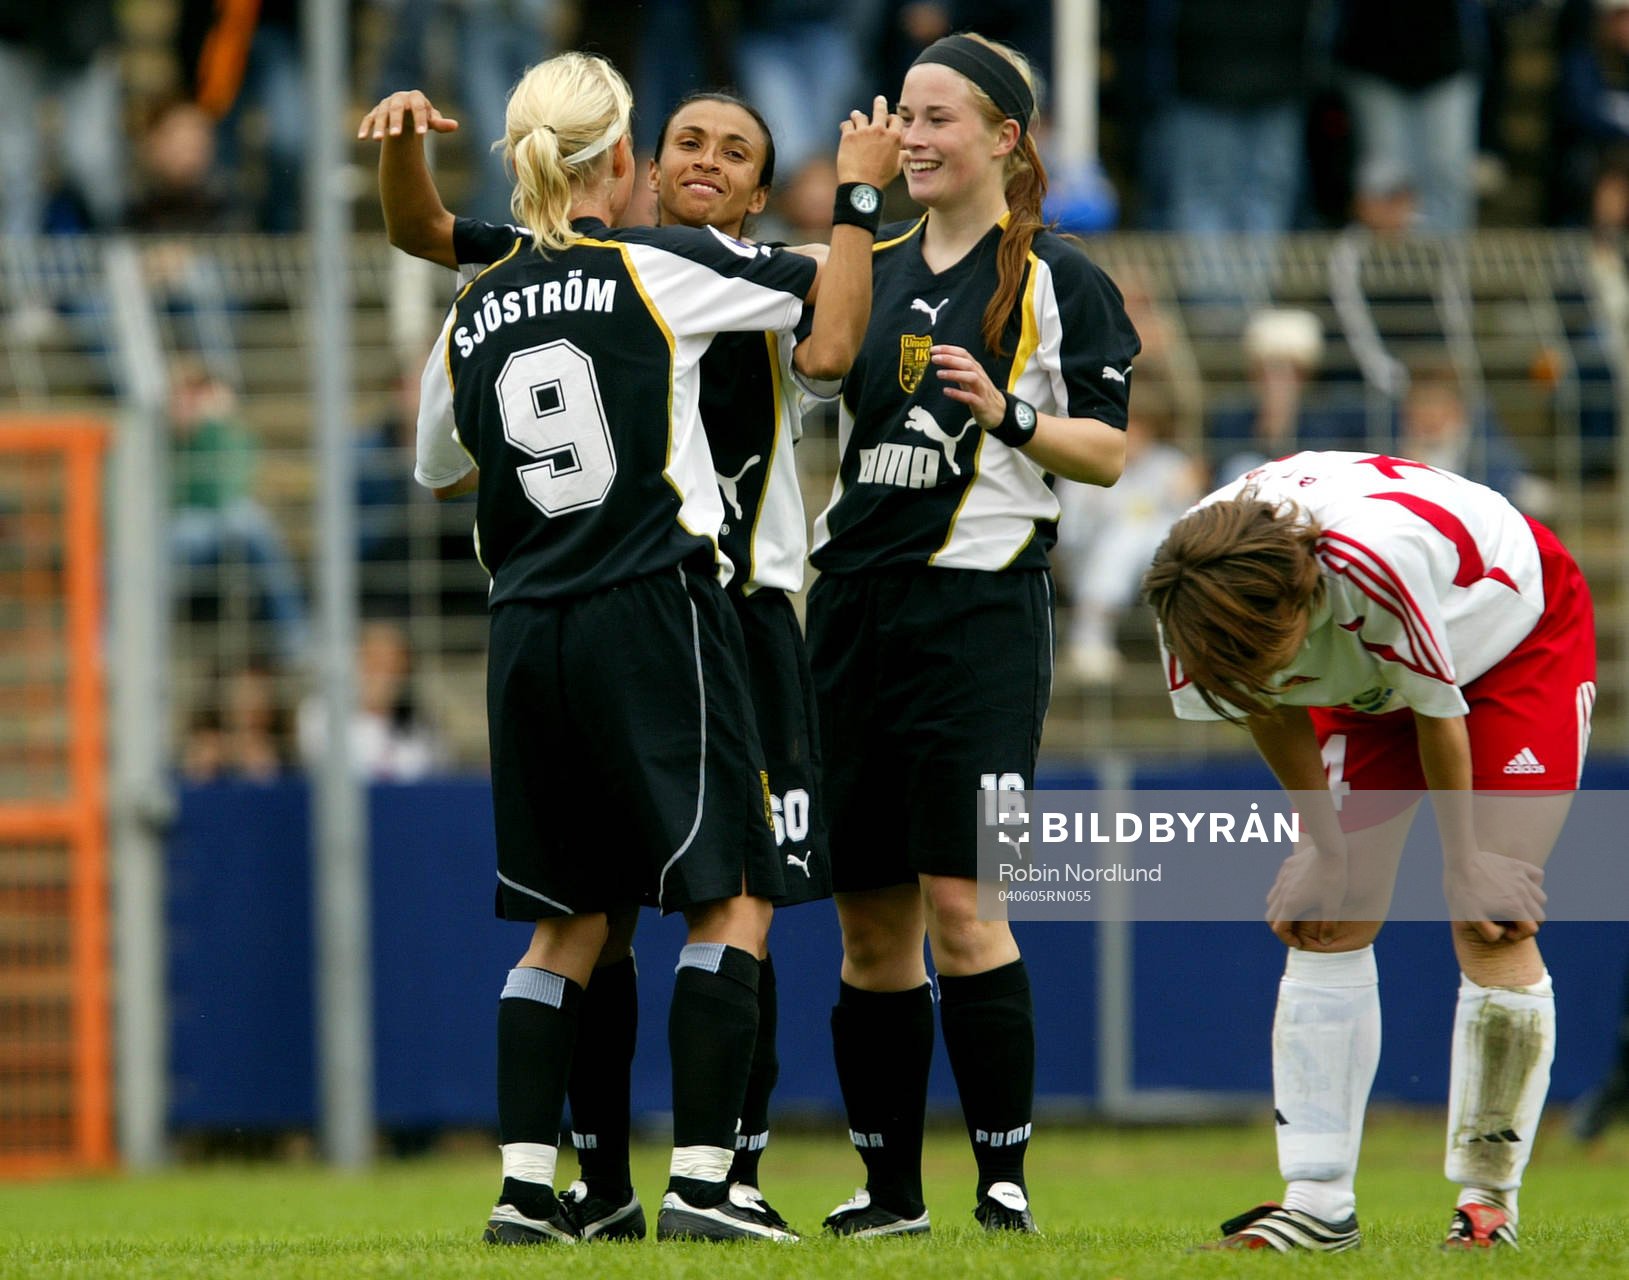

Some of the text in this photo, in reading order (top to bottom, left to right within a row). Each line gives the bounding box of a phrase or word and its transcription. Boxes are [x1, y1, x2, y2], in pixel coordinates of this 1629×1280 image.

[454, 269, 617, 358] SJÖSTRÖM
[915, 348, 928, 361] IK
[495, 338, 617, 519] 9
[980, 772, 1026, 826] 16
